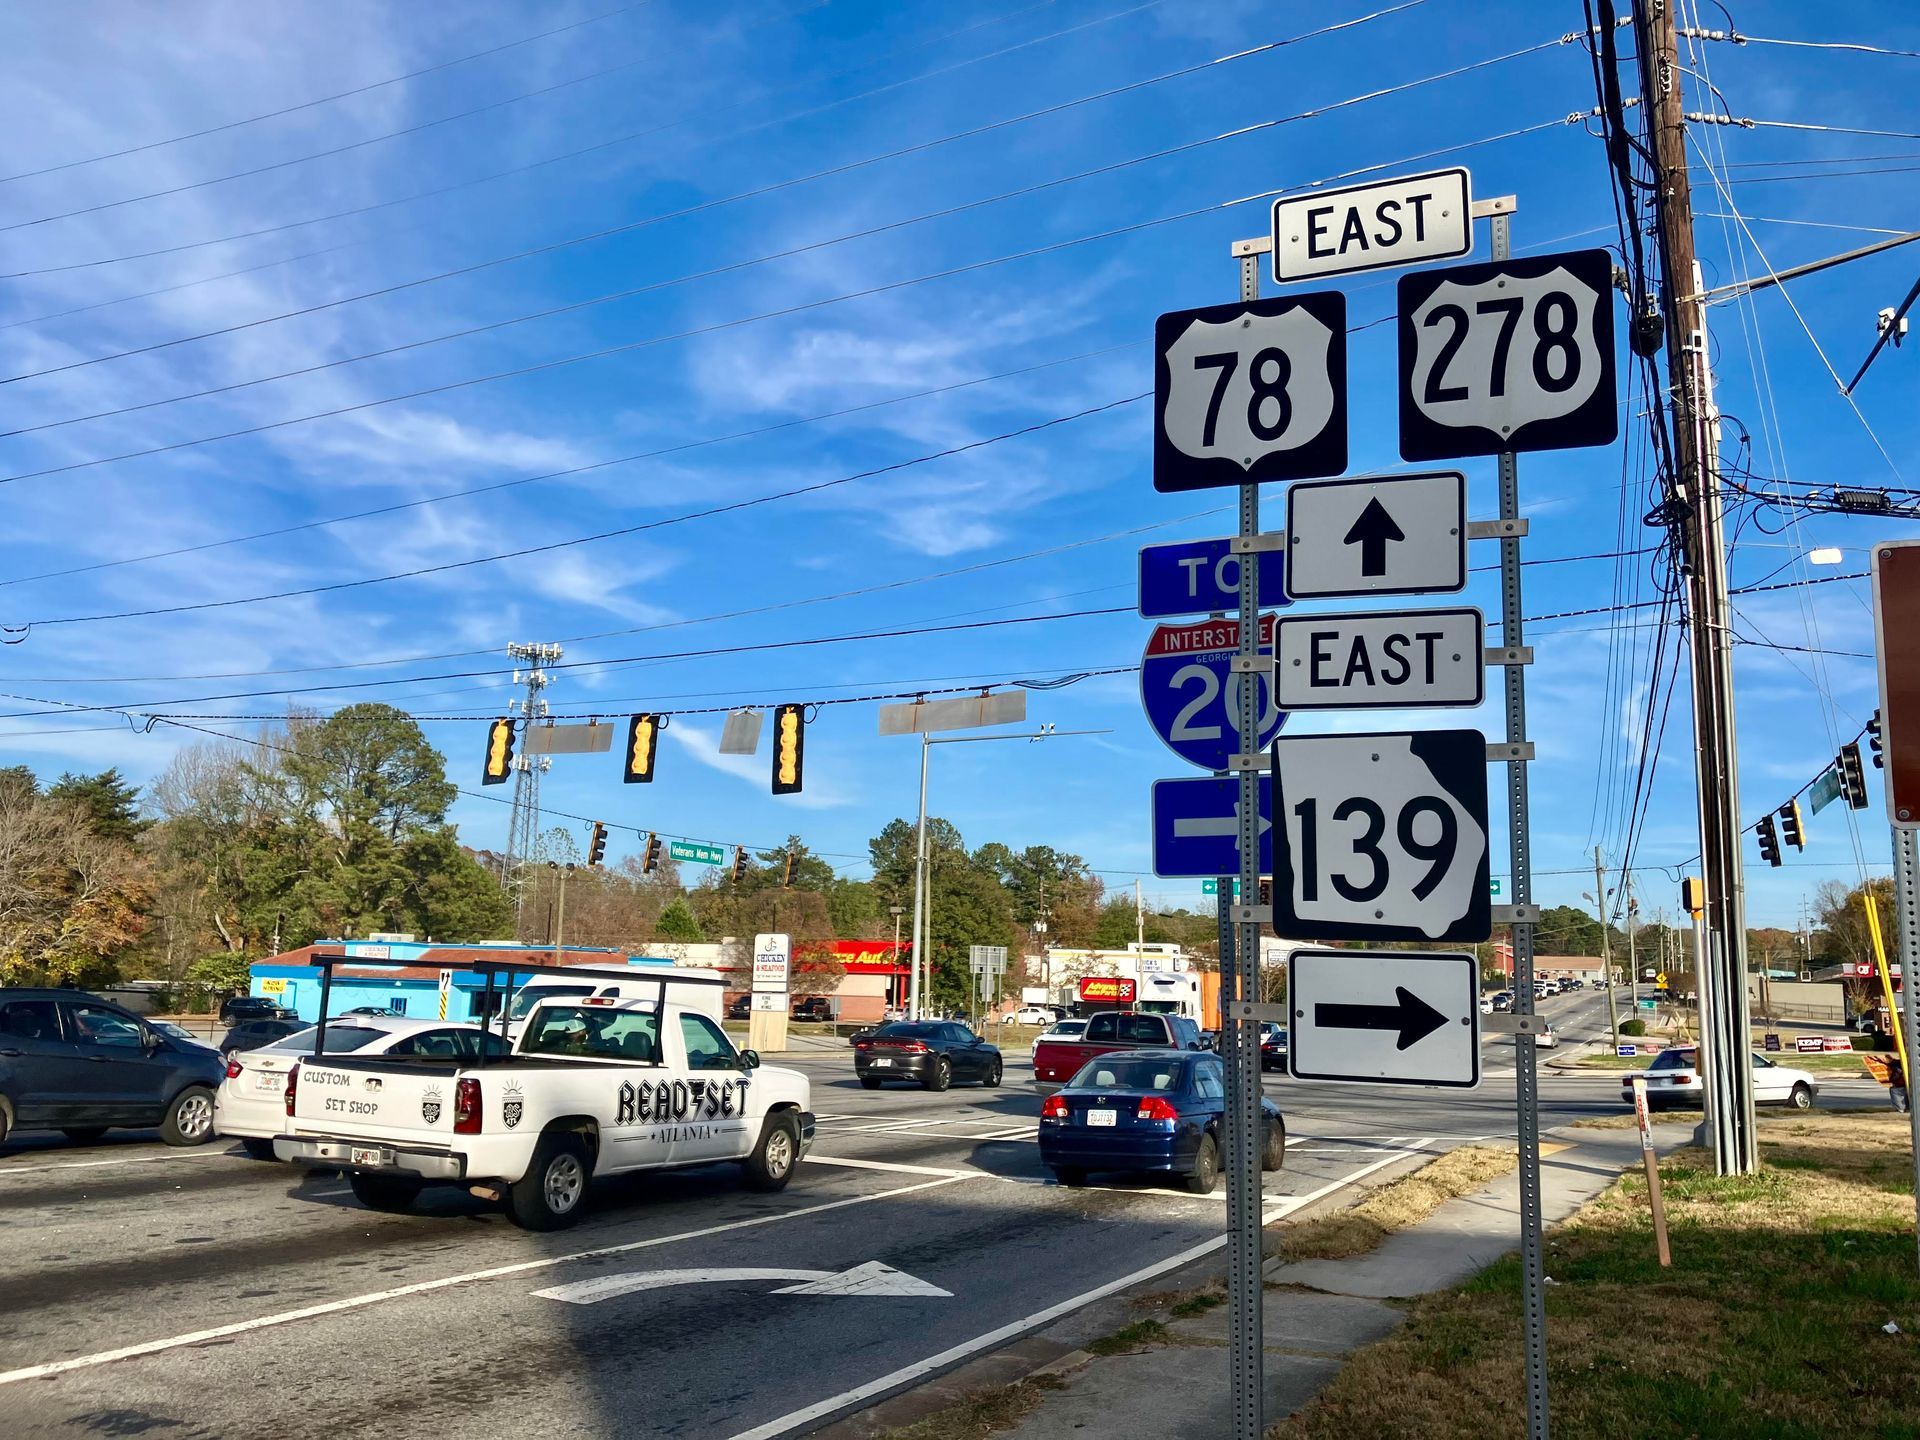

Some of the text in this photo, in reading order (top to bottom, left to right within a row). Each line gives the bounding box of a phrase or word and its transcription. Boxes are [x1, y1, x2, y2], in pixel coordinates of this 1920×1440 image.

[1306, 192, 1433, 260] EAST
[1423, 291, 1582, 404] 278
[1193, 346, 1293, 448] 78
[1178, 554, 1240, 597] TO
[1164, 623, 1270, 651] INTERSTE
[1309, 630, 1444, 688] EAST
[1168, 664, 1279, 742] 20
[672, 844, 722, 864] Veterans Mem Hwy
[1294, 795, 1459, 903] 139
[757, 953, 786, 963] CHICKEN
[761, 964, 786, 972] SEAFOOD
[1085, 981, 1119, 991] Advance
[1798, 1038, 1823, 1047] KEMP
[303, 1071, 351, 1087] CUSTOM
[325, 1097, 379, 1115] SET SHOP
[658, 1125, 711, 1144] ATLANTA
